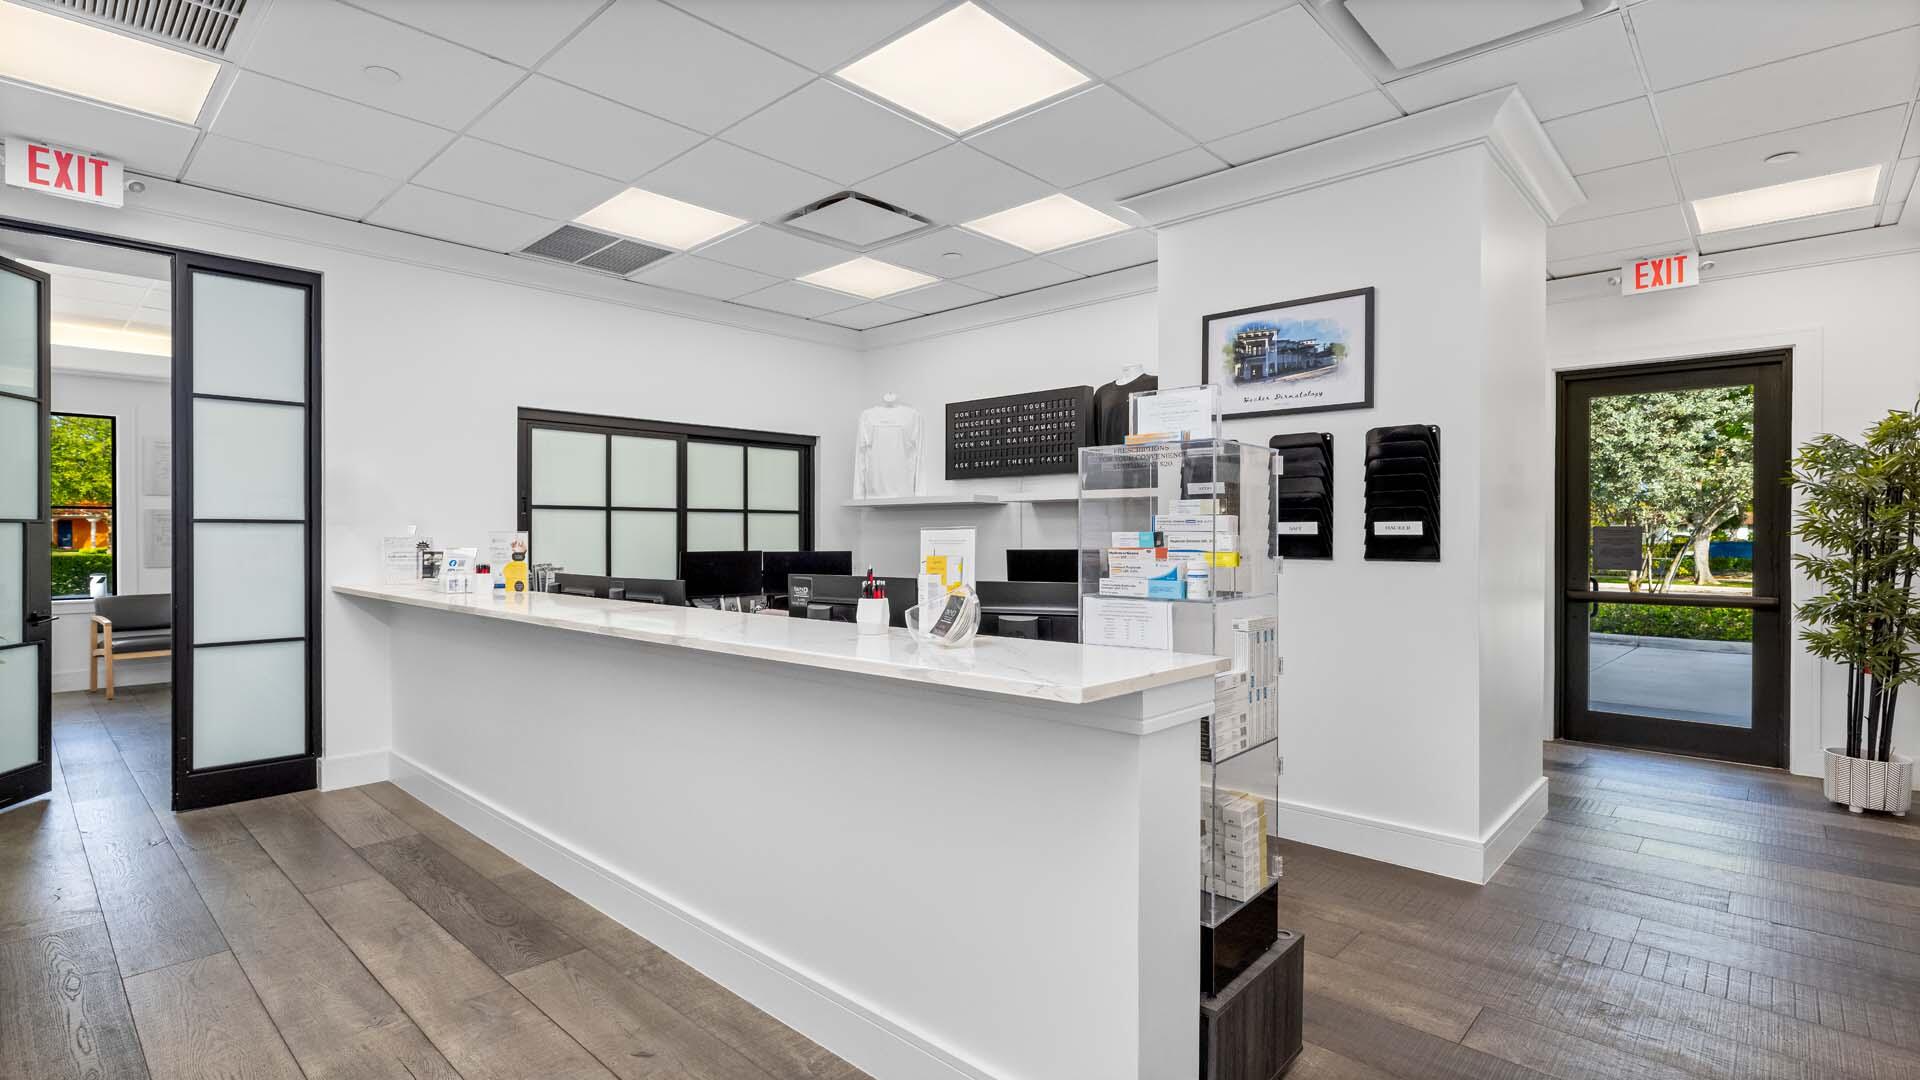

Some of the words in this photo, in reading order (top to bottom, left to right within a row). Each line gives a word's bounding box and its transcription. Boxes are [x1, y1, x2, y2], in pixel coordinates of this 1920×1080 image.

[28, 144, 108, 196] EXIT
[1635, 256, 1687, 289] EXIT
[1274, 390, 1323, 400] Dermatology
[985, 405, 1017, 415] FORGET
[1023, 402, 1046, 410] YOUR
[954, 418, 1001, 429] SUNSCREEN
[1041, 410, 1076, 419] SHIRTS
[970, 429, 989, 437] RAYS
[1030, 421, 1076, 431] DAMAGING
[1006, 436, 1034, 444] RAINY
[975, 459, 1000, 467] STAFF
[1007, 457, 1034, 465] THEIR
